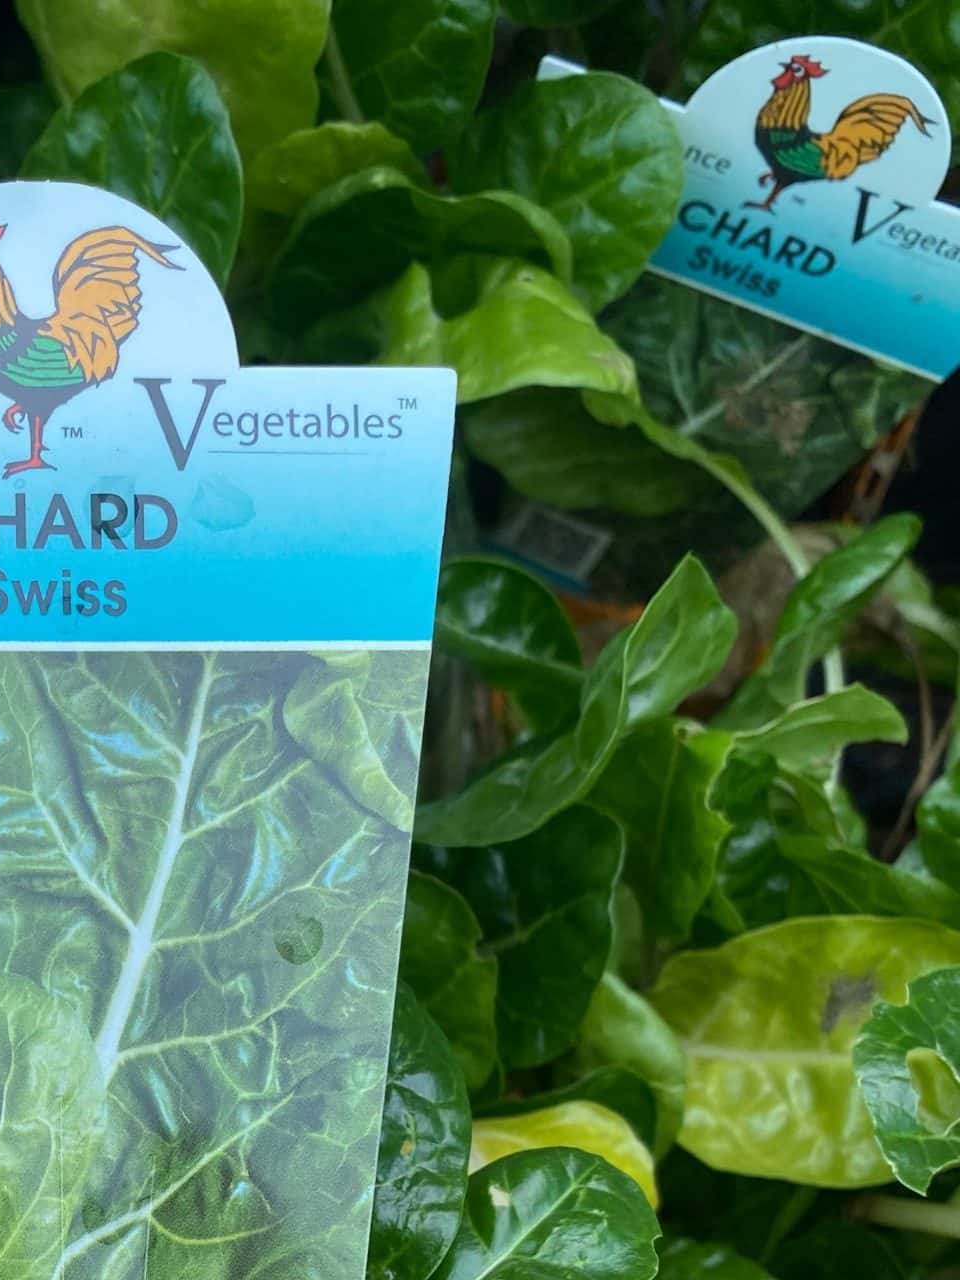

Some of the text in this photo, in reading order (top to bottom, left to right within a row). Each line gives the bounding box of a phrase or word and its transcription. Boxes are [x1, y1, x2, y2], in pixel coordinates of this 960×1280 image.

[678, 201, 837, 278] CHARD
[851, 186, 960, 264] Vegeta
[688, 246, 781, 299] Swiss
[132, 377, 403, 471] Vegetables
